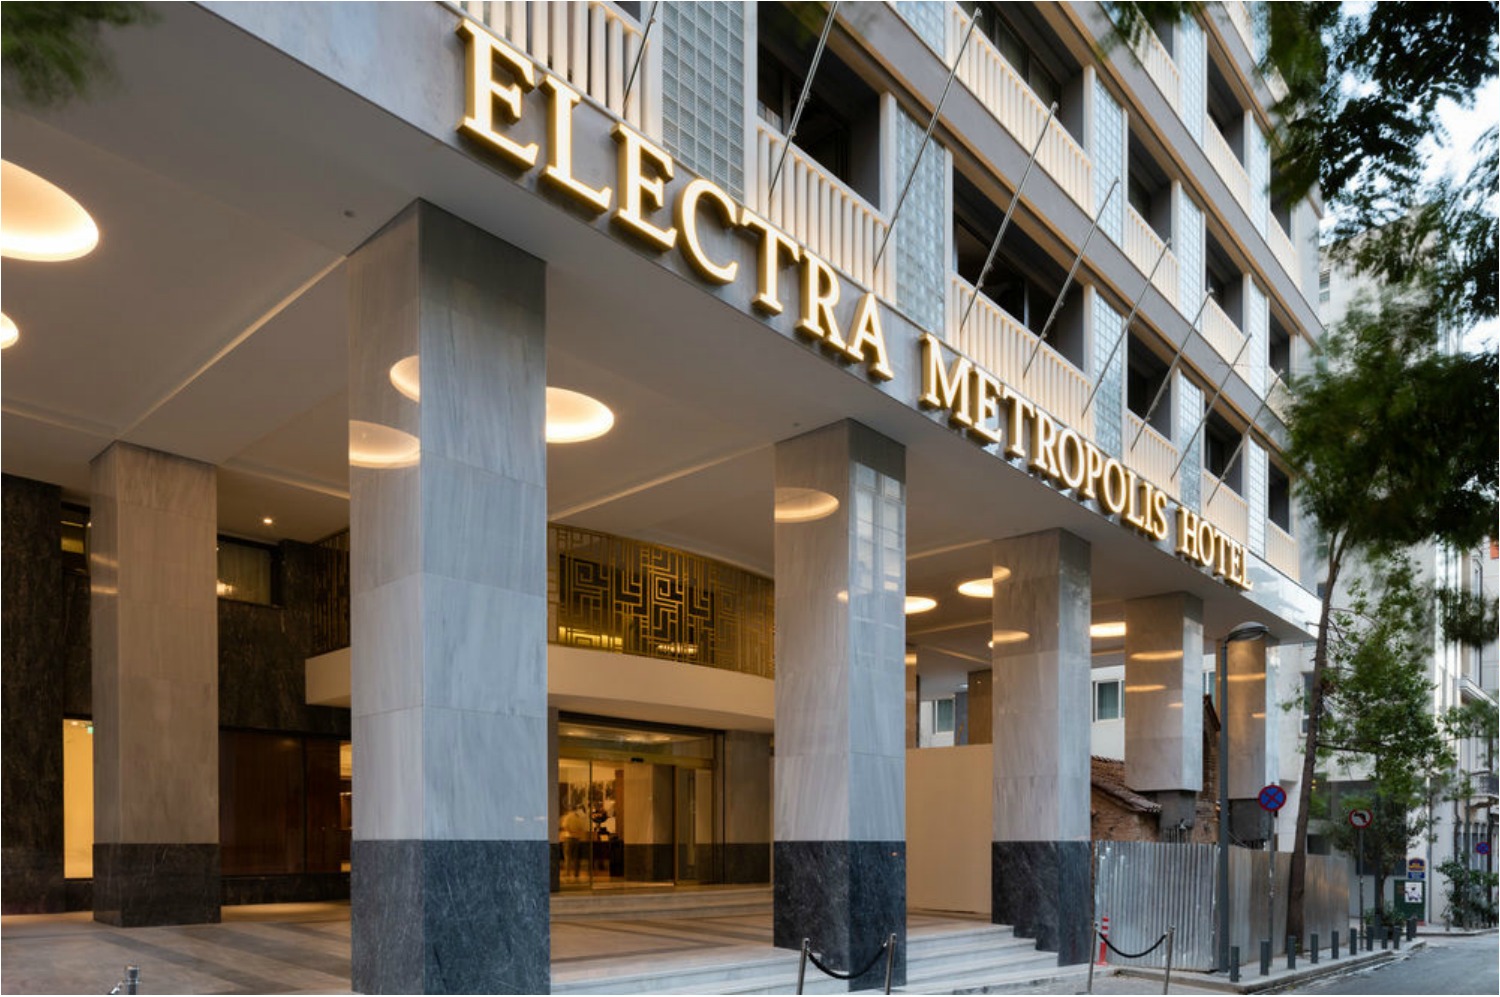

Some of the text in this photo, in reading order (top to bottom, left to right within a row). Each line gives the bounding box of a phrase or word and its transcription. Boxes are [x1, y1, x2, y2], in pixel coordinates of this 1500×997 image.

[455, 18, 1254, 591] ELECTRA METROPOLIS HOTEL
